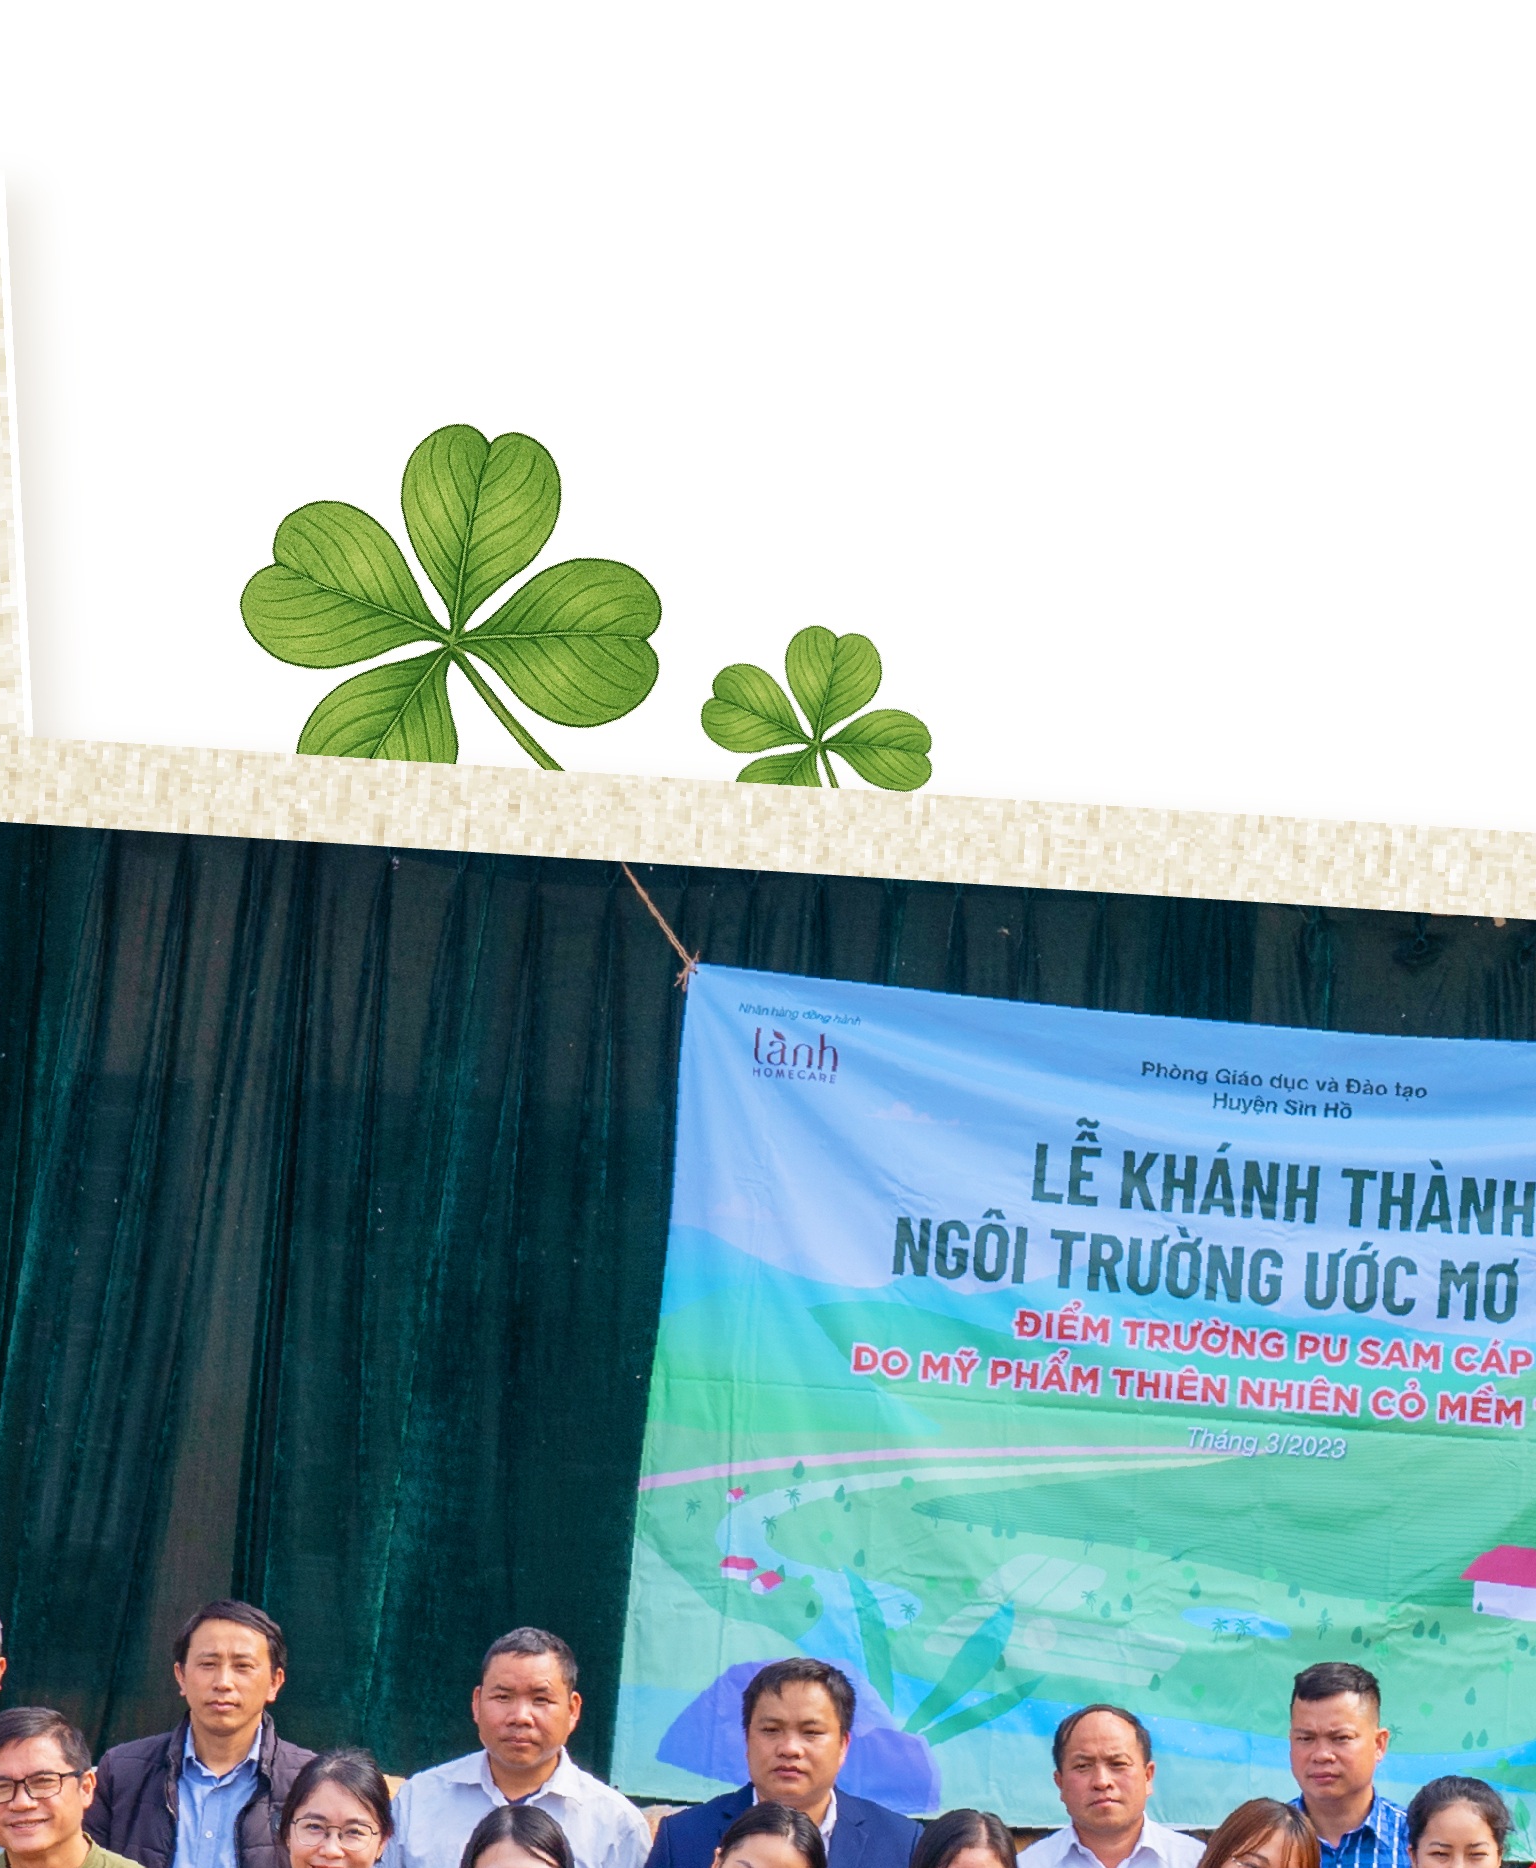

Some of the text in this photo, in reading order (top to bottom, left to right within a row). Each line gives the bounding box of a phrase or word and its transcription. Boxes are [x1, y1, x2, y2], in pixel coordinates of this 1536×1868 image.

[752, 1066, 837, 1084] HOMECARE
[1141, 1060, 1428, 1102] Phòng Giáo dục và Đào tạo
[1212, 1091, 1278, 1116] Huyện
[1323, 1100, 1353, 1120] Hồ
[1031, 1117, 1536, 1237] LỄ KHÁNH THÀNH
[893, 1208, 1027, 1287] NGÔI
[1049, 1226, 1282, 1306] TRƯỜNG
[1304, 1242, 1417, 1320] ƯỚC
[1438, 1259, 1518, 1325] MƠ
[1014, 1302, 1534, 1377] ĐIỂM TRƯỜNG PU SAM CÁP
[851, 1345, 910, 1377] DO
[922, 1349, 979, 1384] MỸ
[989, 1349, 1100, 1395] PHẨM
[1113, 1368, 1227, 1404] THIÊN
[1238, 1377, 1359, 1415] NHIÊN
[1371, 1380, 1427, 1419] CỎ
[1438, 1385, 1524, 1427] MỀM
[1187, 1425, 1349, 1460] Tháng 3/2023
